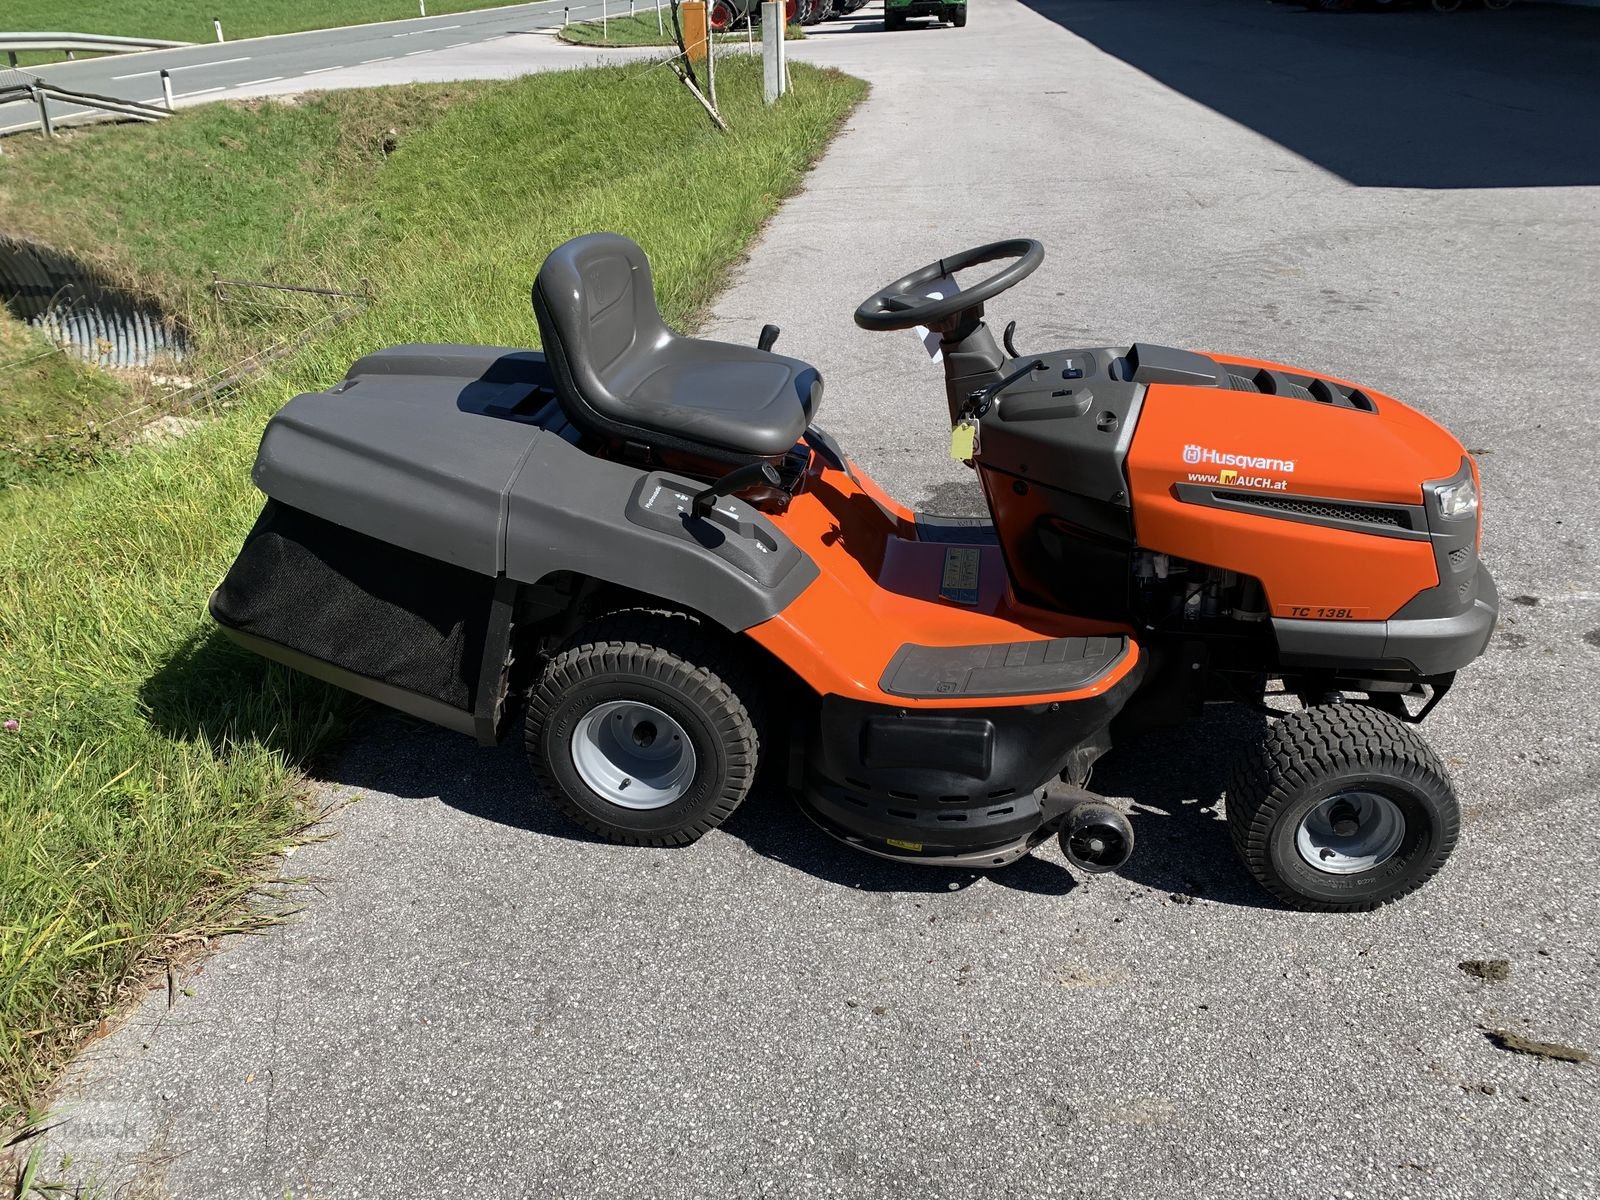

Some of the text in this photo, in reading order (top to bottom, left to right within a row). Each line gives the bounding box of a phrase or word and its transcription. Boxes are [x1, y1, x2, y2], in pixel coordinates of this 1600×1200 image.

[1203, 449, 1294, 473] Husqvarna
[1188, 471, 1287, 490] www.MAUCH.at
[1292, 607, 1353, 618] TC 138L
